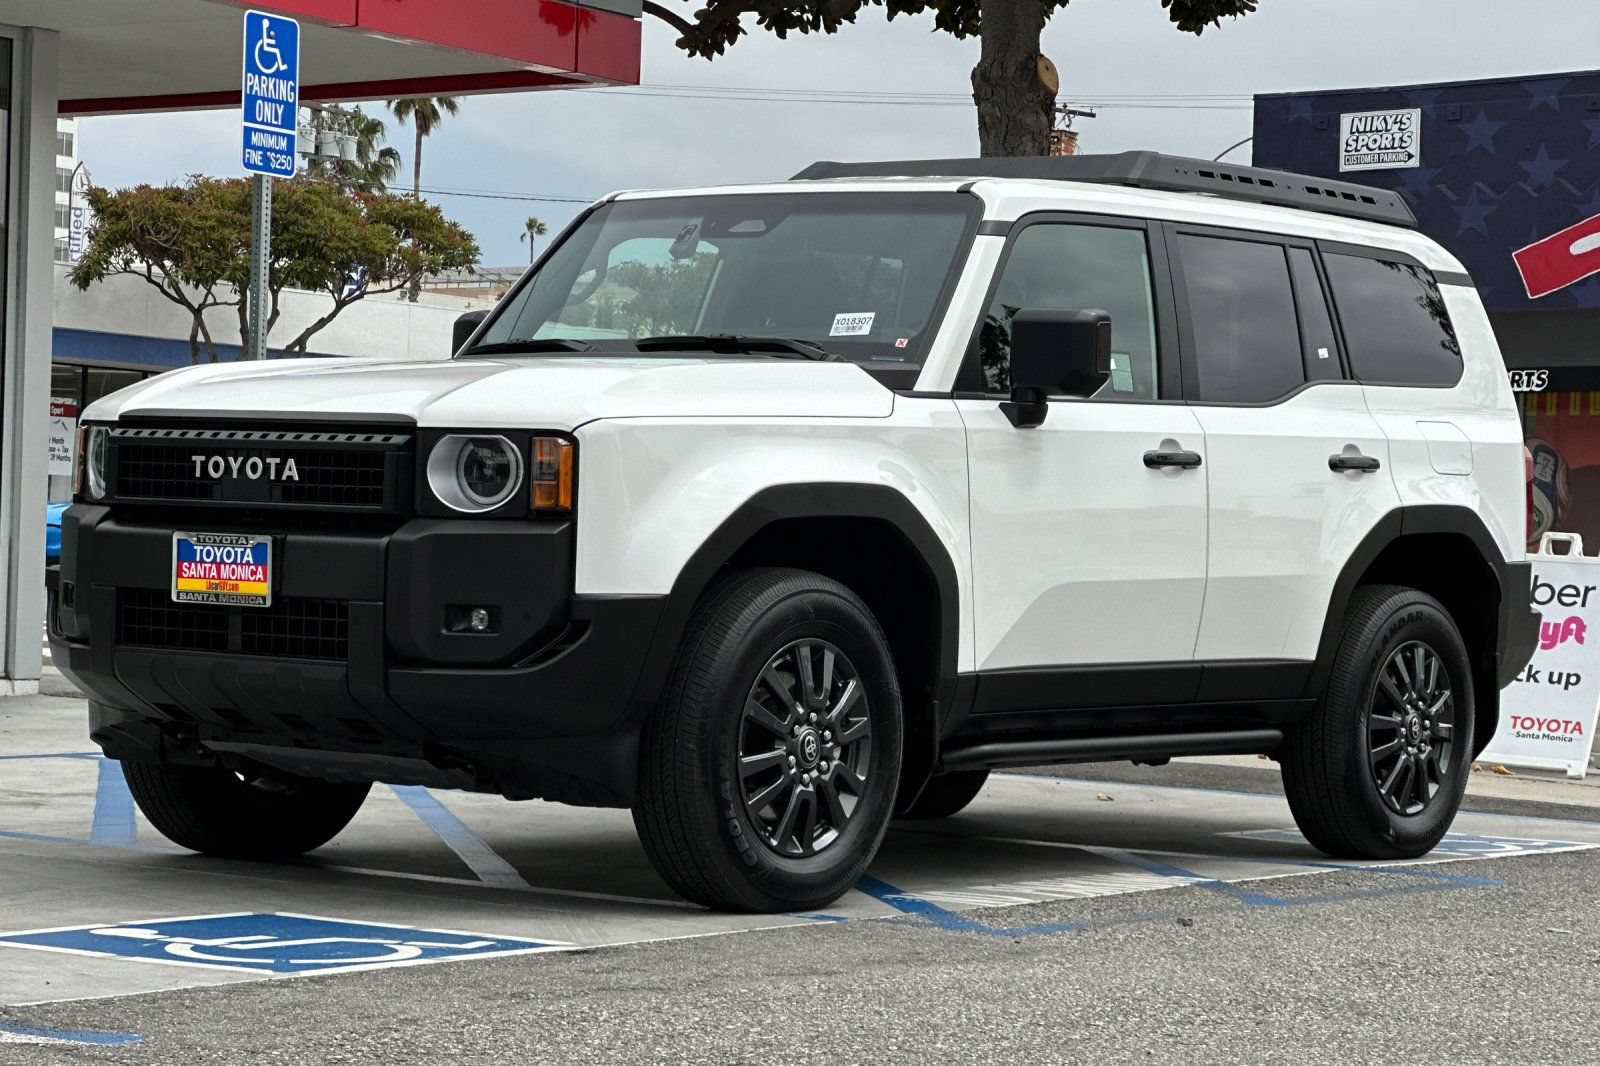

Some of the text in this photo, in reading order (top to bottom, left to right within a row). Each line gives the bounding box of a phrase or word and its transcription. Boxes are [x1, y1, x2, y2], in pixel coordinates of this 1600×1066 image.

[246, 73, 294, 103] PARKING
[256, 100, 284, 125] ONLY
[1350, 113, 1412, 134] NIKY'S
[251, 131, 287, 151] MINIMUM
[1344, 131, 1413, 152] SPORTS
[245, 149, 292, 170] FINE $250
[1345, 151, 1409, 165] CUSTOMER PARKING
[835, 317, 873, 326] X018307
[1509, 370, 1549, 392] RTS
[191, 455, 299, 480] TOYOTA
[197, 535, 247, 544] TOYOTA
[193, 546, 253, 564] TOYOTA
[182, 562, 264, 581] SANTA MONICA
[179, 592, 264, 605] SANTA MONICA
[1540, 616, 1588, 650] yft
[1547, 669, 1582, 691] up
[1511, 716, 1584, 735] TOYOTA
[1515, 730, 1574, 743] Santa Monica
